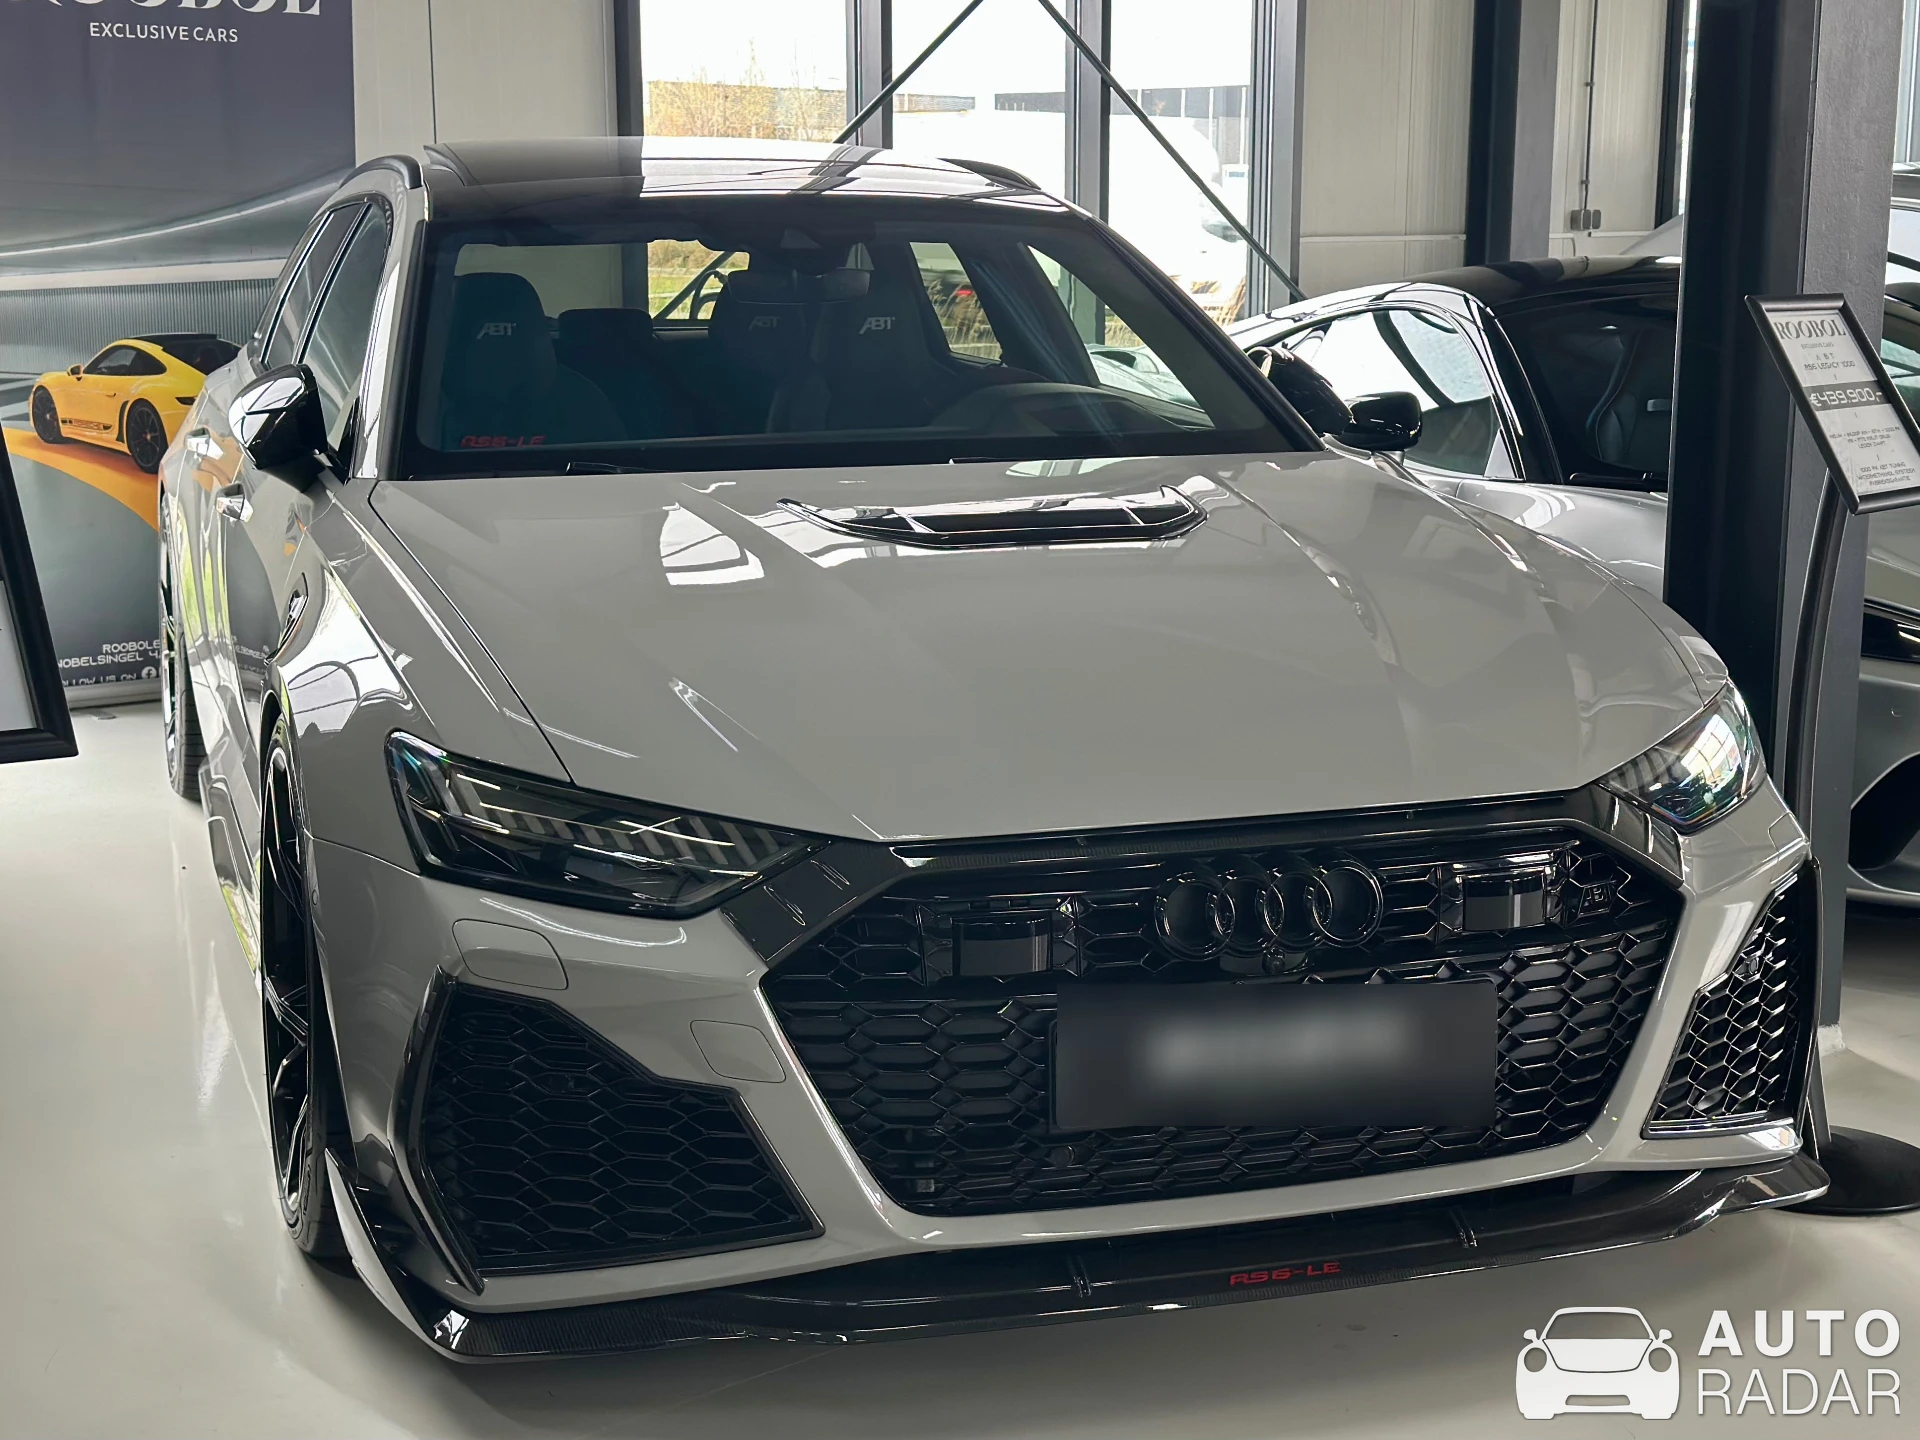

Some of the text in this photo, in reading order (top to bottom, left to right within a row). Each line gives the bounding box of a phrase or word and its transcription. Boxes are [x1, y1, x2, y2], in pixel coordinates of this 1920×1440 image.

[89, 22, 239, 43] EXCLUSIVE CARS
[476, 322, 513, 340] ABT
[858, 316, 892, 335] ABT
[1773, 319, 1846, 340] ROOBOL
[1229, 1261, 1341, 1287] RS6-LE
